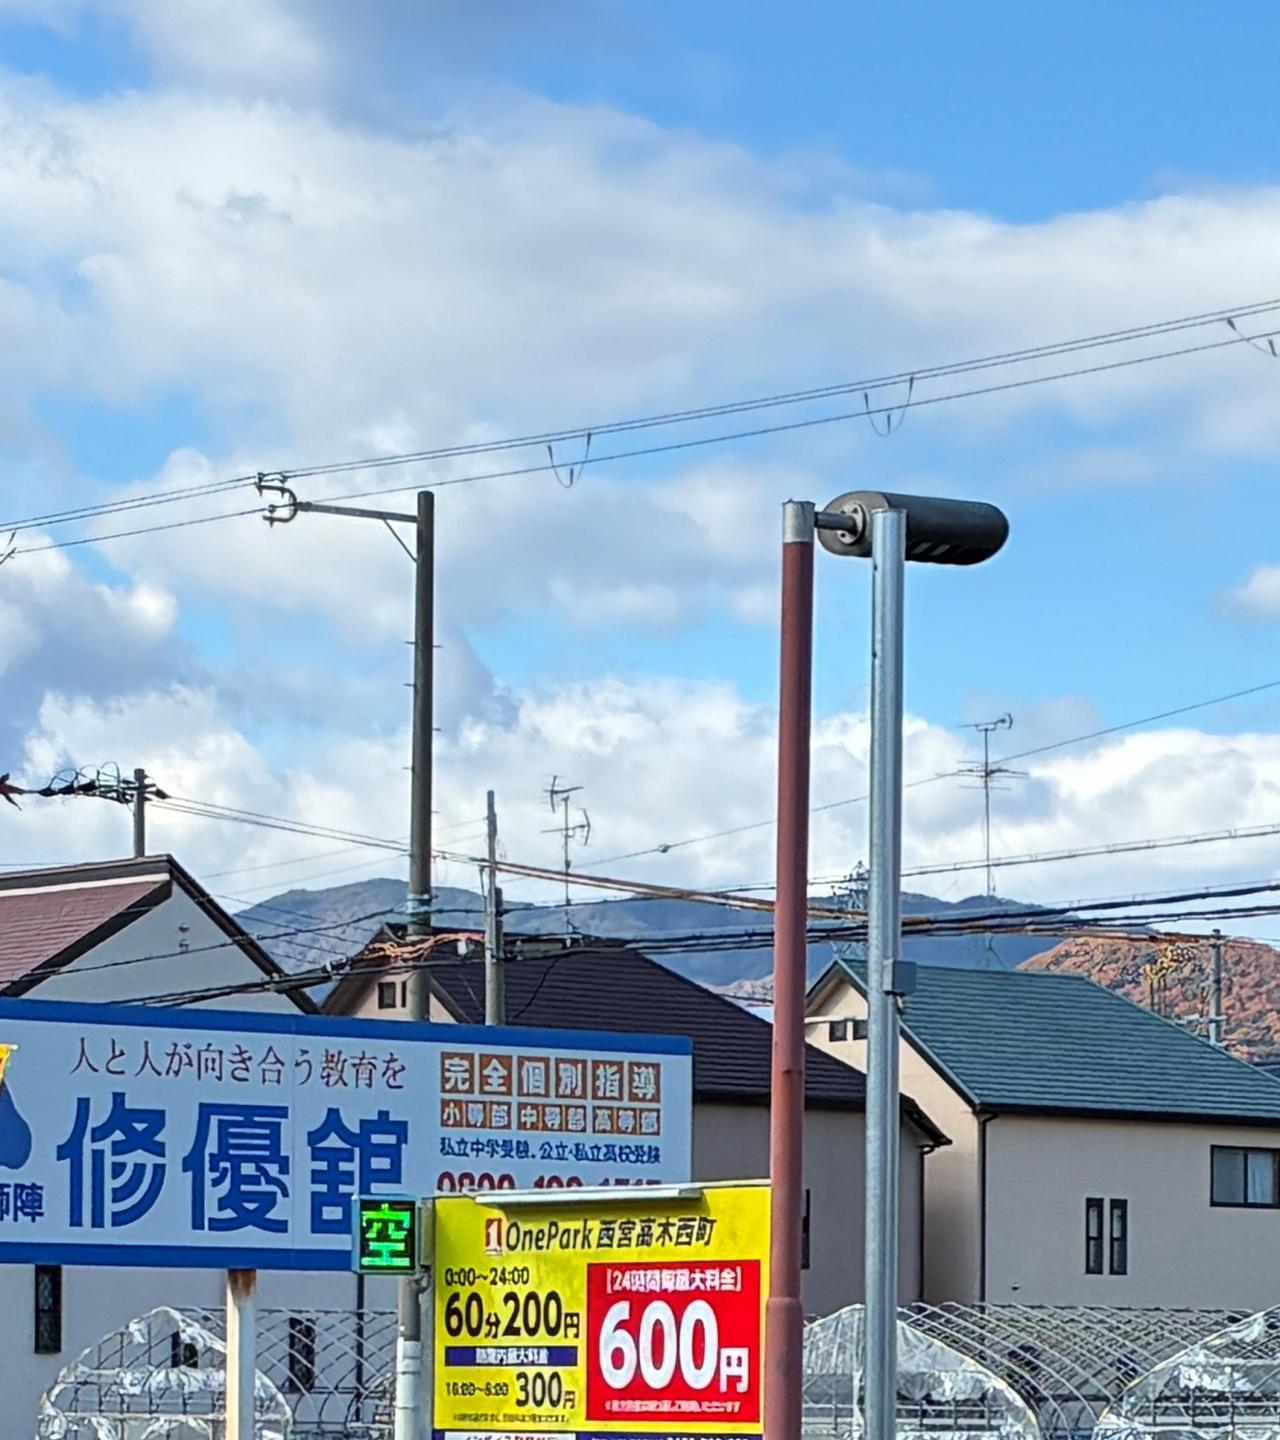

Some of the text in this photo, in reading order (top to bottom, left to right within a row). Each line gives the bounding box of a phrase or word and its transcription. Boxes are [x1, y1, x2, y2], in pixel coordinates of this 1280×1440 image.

[70, 1036, 407, 1090] 人と人が向き合う教育を
[442, 1056, 656, 1101] 完全個別指導
[361, 1203, 410, 1267] 空
[506, 1218, 593, 1252] OnePark
[596, 1216, 717, 1249] 西宮高木西町
[599, 1300, 749, 1393] 600円
[515, 1371, 576, 1409] 300円
